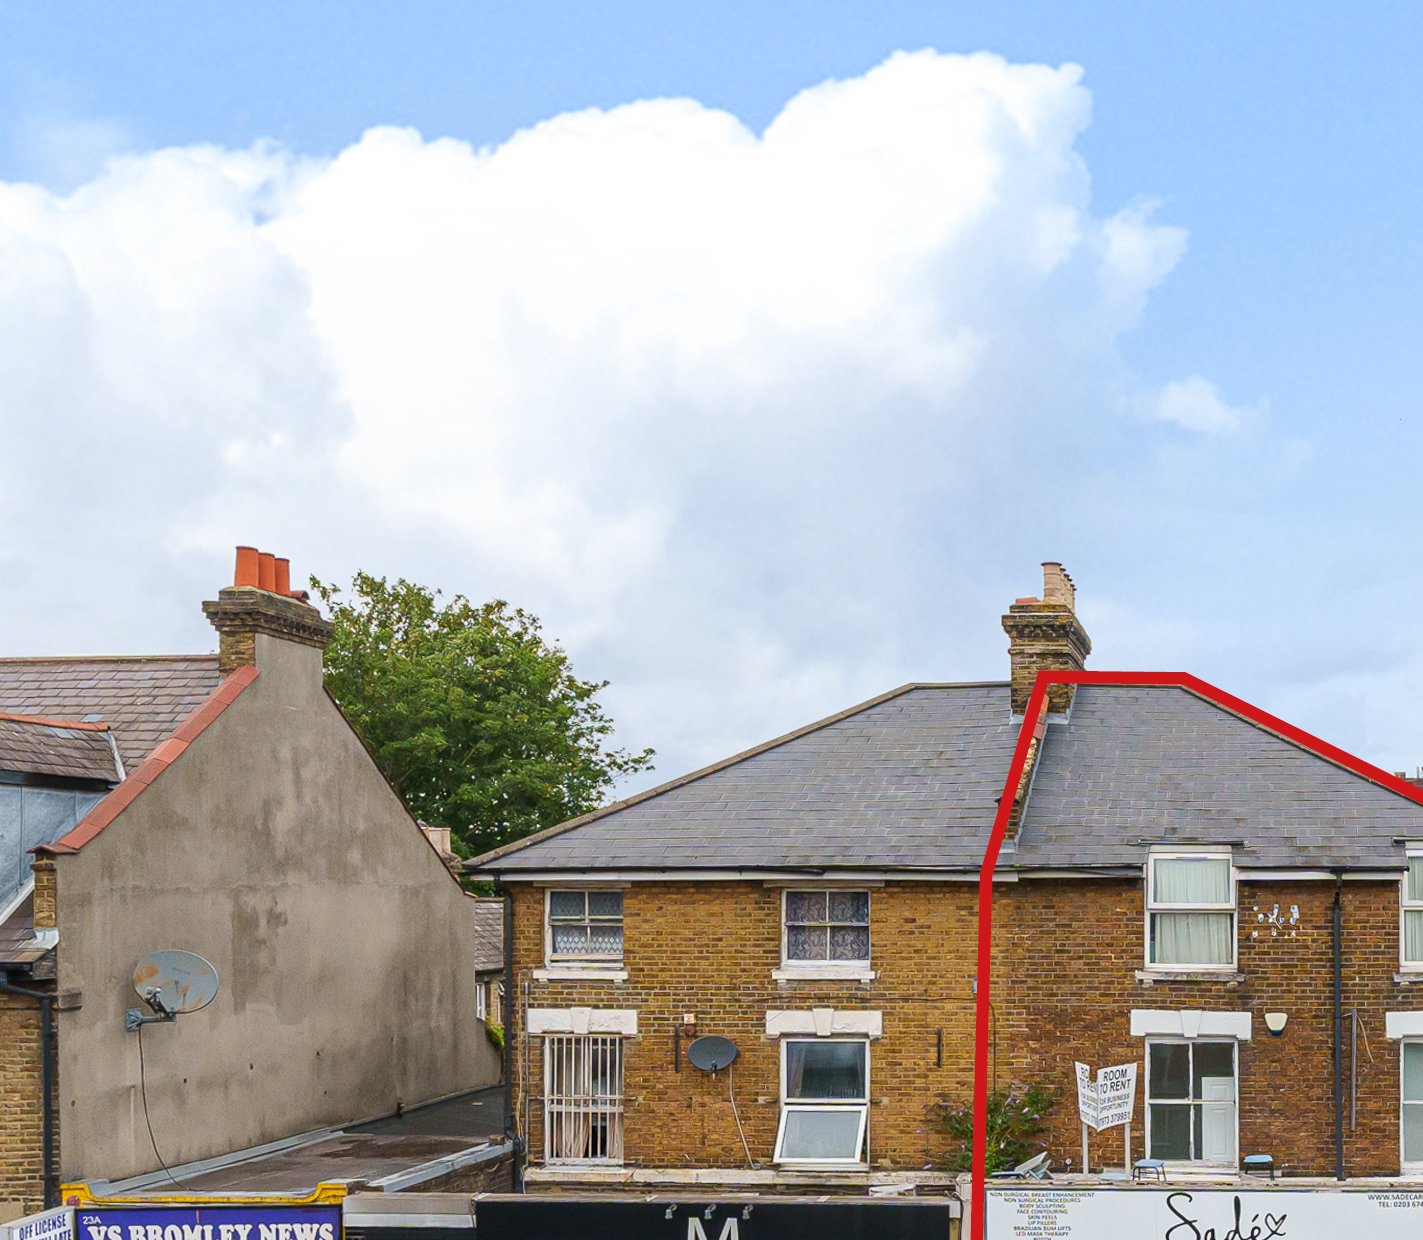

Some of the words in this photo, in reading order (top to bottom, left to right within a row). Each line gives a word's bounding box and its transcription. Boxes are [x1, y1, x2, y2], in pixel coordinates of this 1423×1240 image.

[1103, 1068, 1127, 1081] ROOM
[1100, 1082, 1108, 1095] TO
[1109, 1079, 1131, 1092] RENT
[35, 1214, 66, 1236] LICENSE
[82, 1216, 101, 1225] 23A
